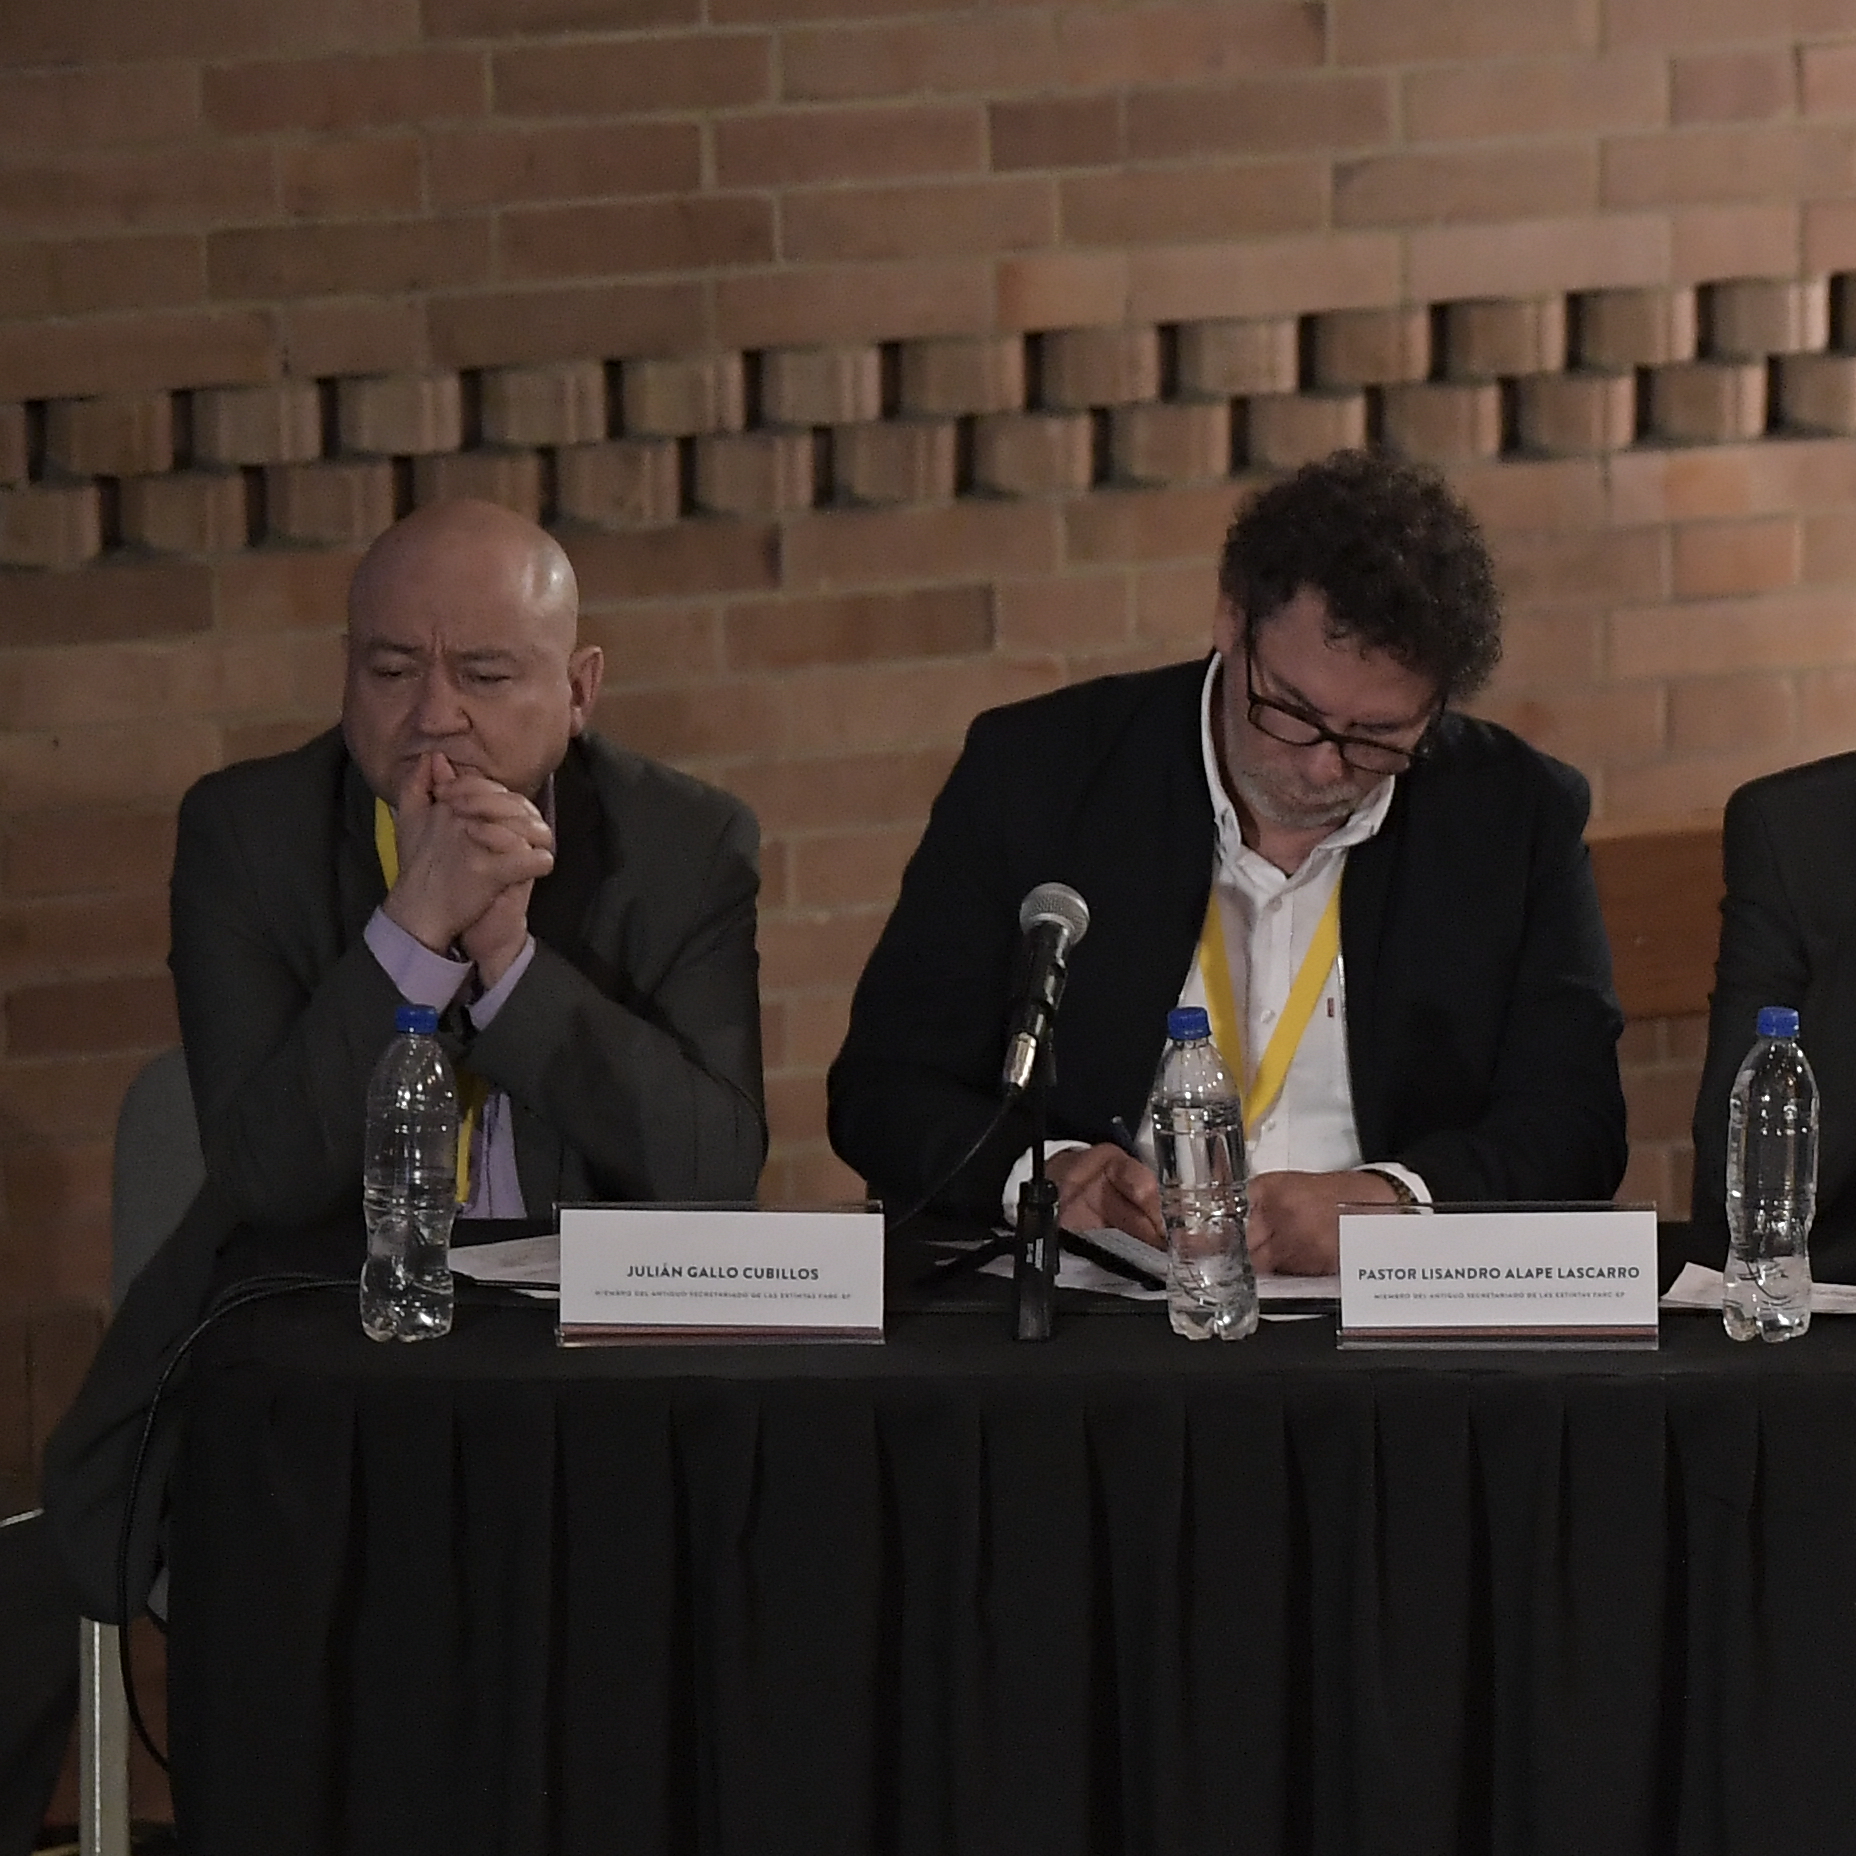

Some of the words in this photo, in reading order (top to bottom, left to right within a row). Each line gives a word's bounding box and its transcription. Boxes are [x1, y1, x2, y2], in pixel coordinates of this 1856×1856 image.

[626, 1262, 683, 1278] JULIÁN
[686, 1266, 739, 1279] GALLO
[742, 1267, 819, 1281] CUBILLOS
[1358, 1268, 1417, 1281] PASTOR
[1421, 1267, 1501, 1280] LISANDRO
[1504, 1267, 1553, 1280] ALAPE
[1557, 1266, 1640, 1279] LASCARRO
